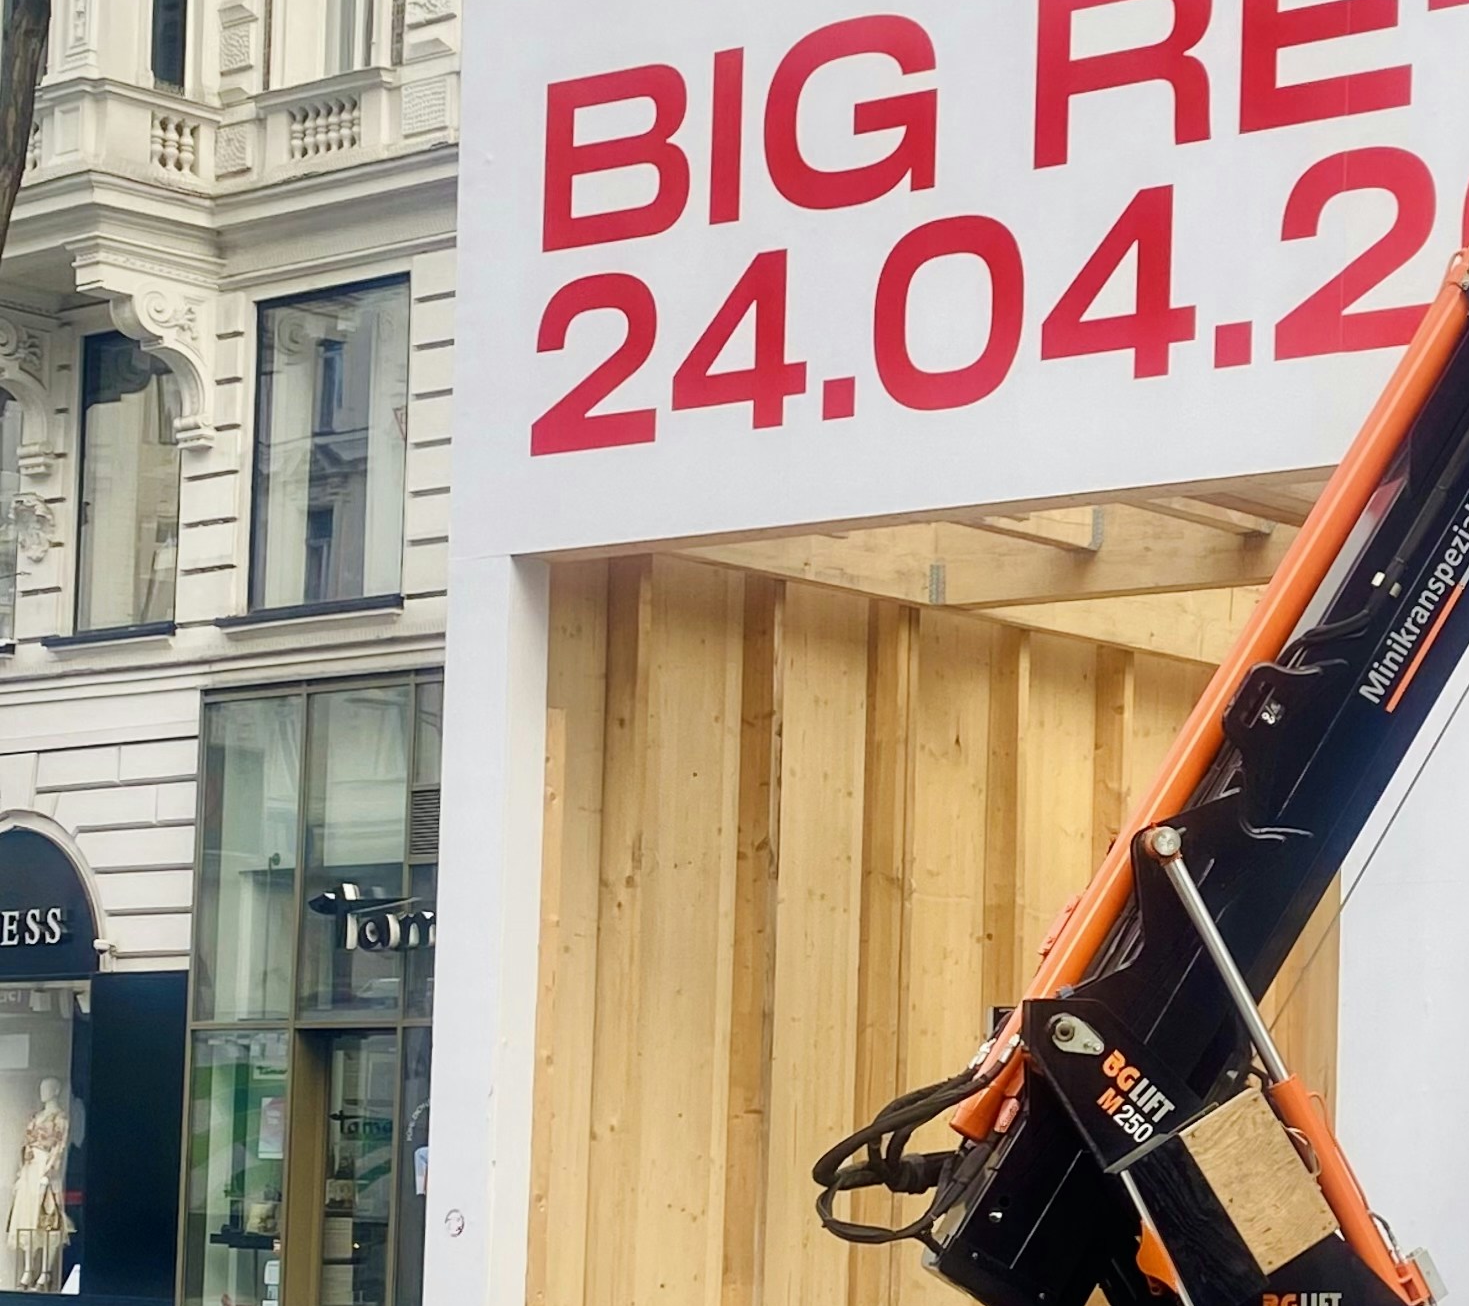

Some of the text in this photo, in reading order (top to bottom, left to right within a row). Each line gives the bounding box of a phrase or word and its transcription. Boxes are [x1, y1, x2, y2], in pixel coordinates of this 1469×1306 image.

[541, 13, 938, 253] BIG
[0, 907, 61, 946] ESS
[1096, 1086, 1154, 1143] M250
